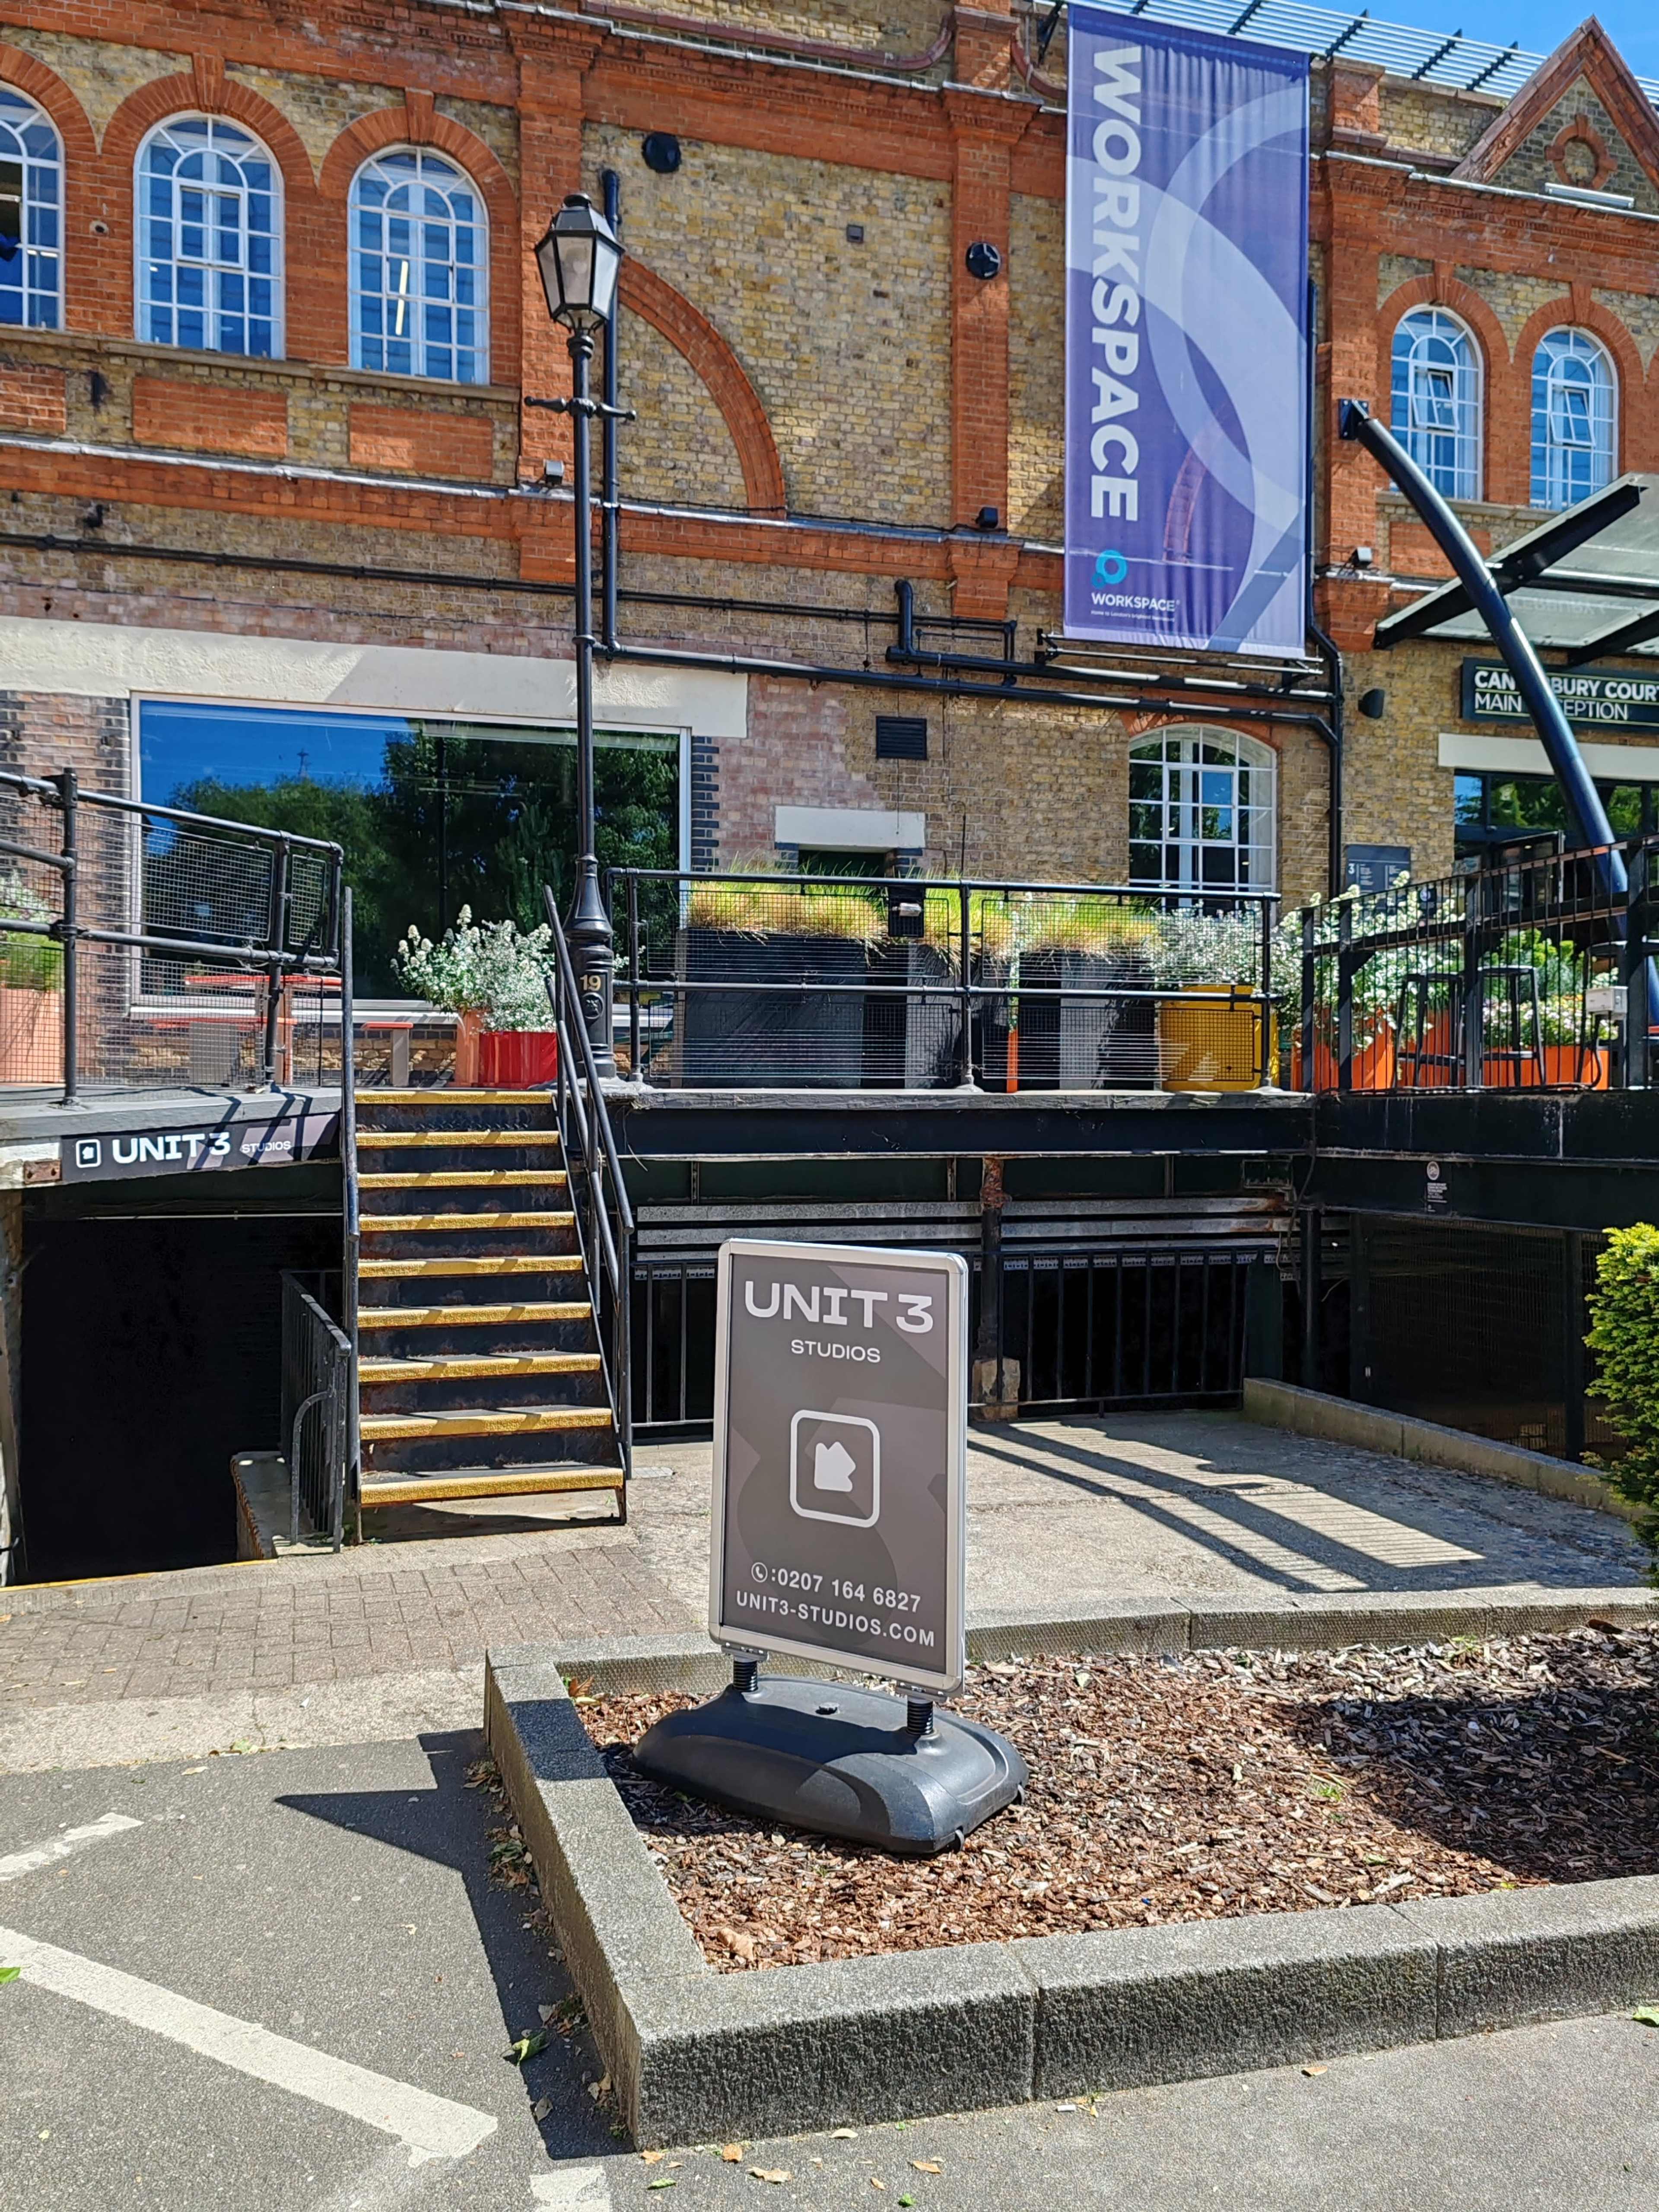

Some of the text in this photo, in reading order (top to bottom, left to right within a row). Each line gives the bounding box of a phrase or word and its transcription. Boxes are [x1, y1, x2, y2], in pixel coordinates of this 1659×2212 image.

[1090, 46, 1142, 522] WORKSPACE
[1091, 592, 1175, 611] WORKSPACE
[1475, 671, 1659, 702] CANBURY COUR
[1475, 693, 1522, 712] MAIN
[1348, 864, 1355, 874] 3
[580, 974, 601, 991] 19
[241, 1141, 292, 1154] STUDIOS
[791, 1339, 881, 1363] STUDIOS
[831, 1579, 865, 1602] 164
[873, 1587, 921, 1613] 6827
[736, 1590, 934, 1647] UNIT3-STUDIOS.COM
